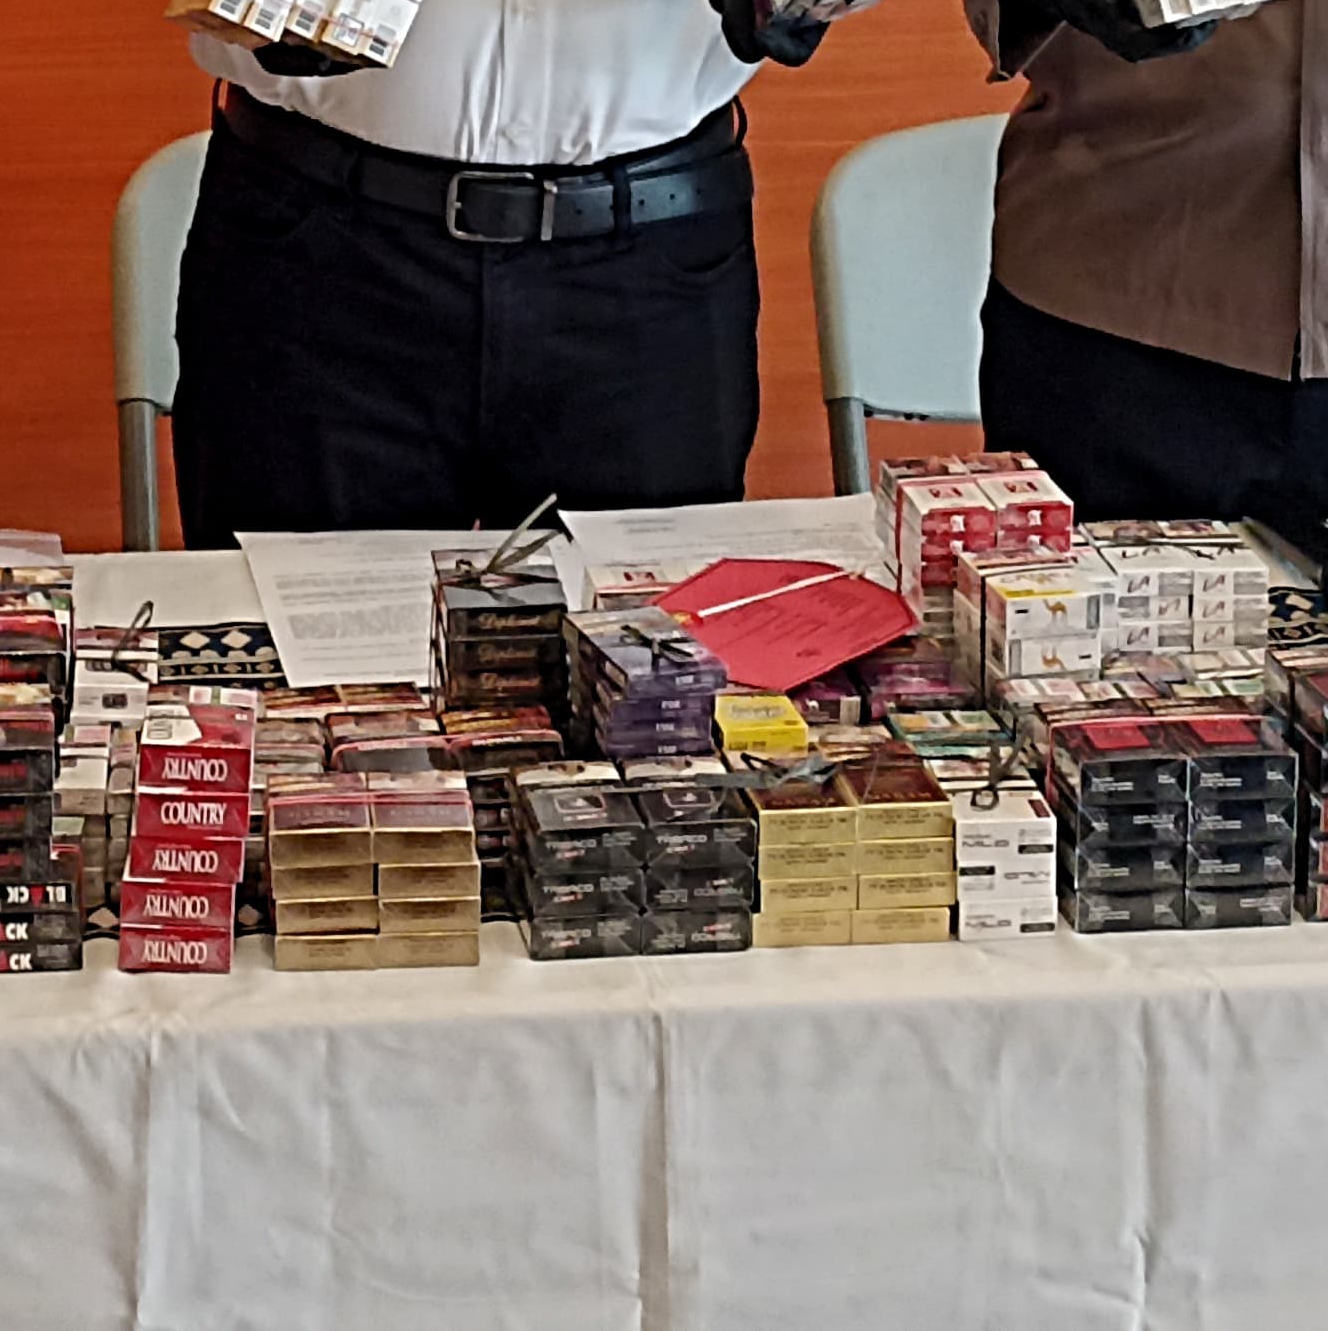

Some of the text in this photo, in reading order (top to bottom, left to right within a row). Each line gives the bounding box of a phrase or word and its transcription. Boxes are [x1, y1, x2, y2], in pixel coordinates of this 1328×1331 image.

[162, 757, 228, 781] COUNTRY
[160, 801, 227, 825] COUNTRY
[152, 849, 219, 873] COUNTRY
[143, 895, 210, 918] COUNTRY
[141, 941, 208, 964] COUNTRY
